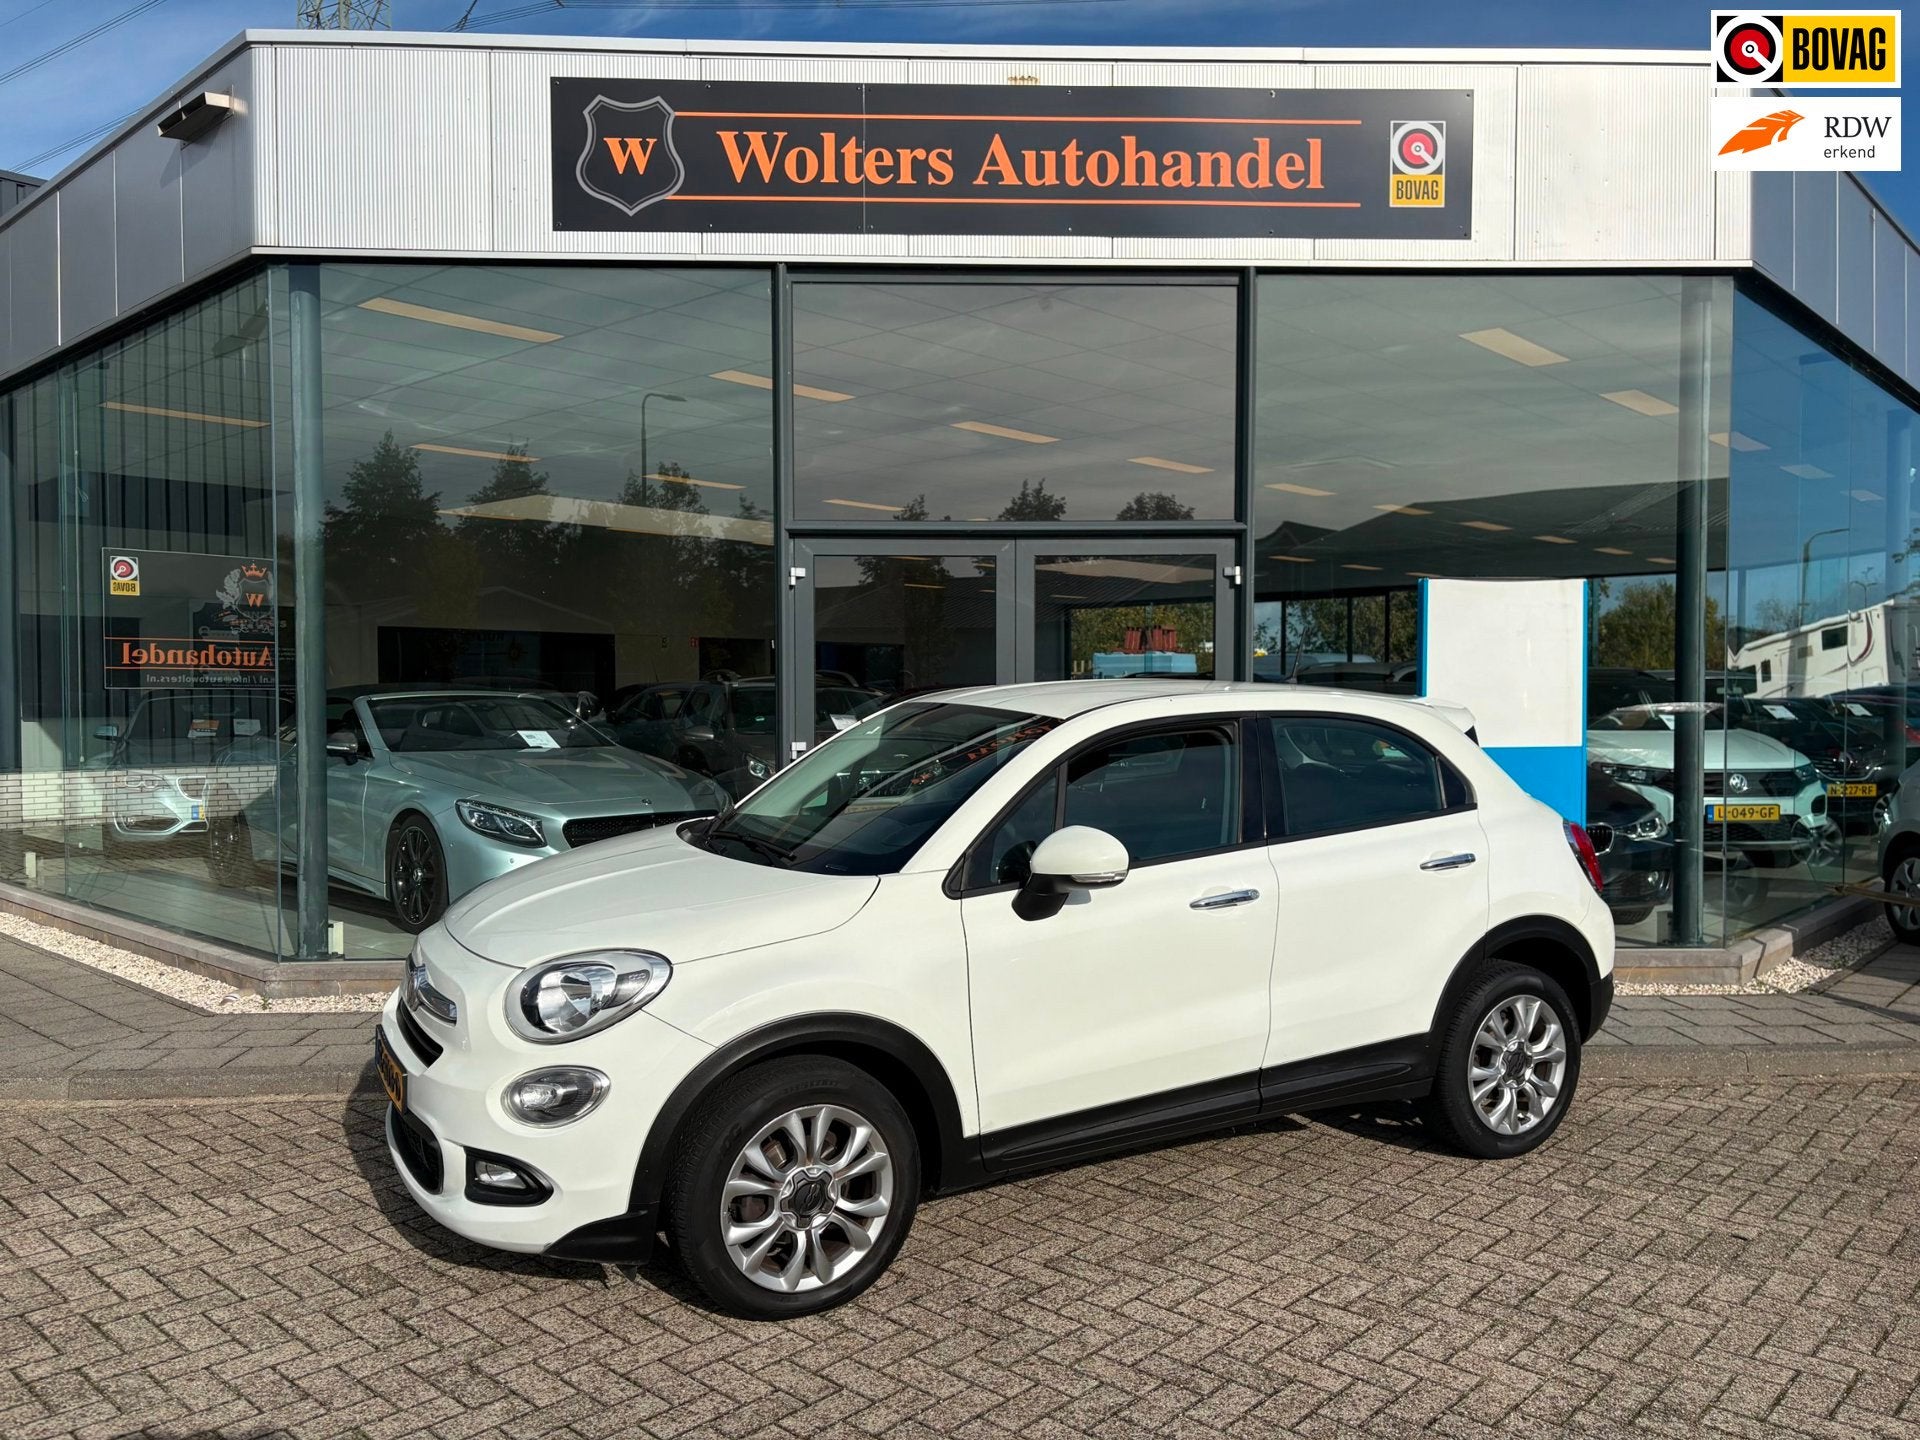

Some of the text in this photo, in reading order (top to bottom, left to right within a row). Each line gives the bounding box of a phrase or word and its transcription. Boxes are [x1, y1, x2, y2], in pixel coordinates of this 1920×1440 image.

[603, 137, 658, 175] W
[716, 131, 1325, 190] Wolters Autohandel
[1396, 179, 1440, 201] BOVAG
[1718, 807, 1775, 818] L-049-GF
